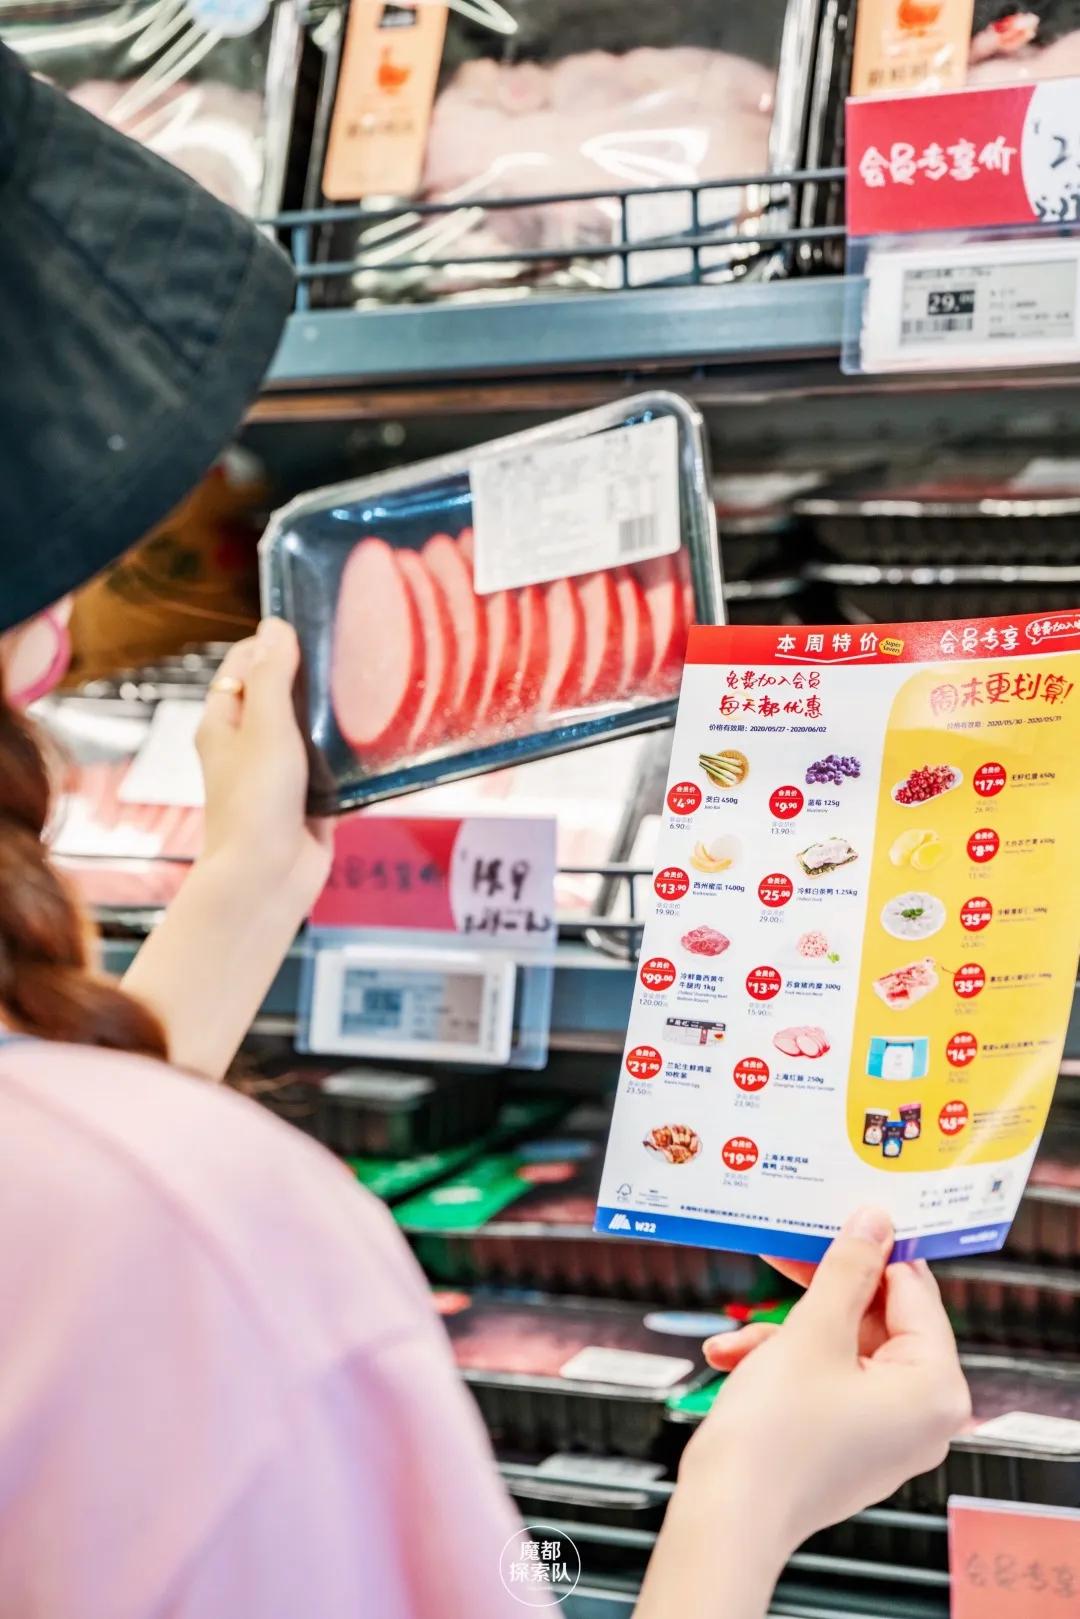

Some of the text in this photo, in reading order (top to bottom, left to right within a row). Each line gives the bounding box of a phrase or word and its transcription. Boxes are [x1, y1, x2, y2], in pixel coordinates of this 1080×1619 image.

[859, 135, 1018, 188] 会员专享价
[777, 632, 879, 653] 本周特价
[939, 625, 1020, 654] 会员专享
[726, 670, 821, 690] 免费加入会员
[719, 695, 823, 719] 每天都优惠
[673, 798, 695, 808] ¥4.90
[722, 797, 738, 805] 450g
[775, 801, 798, 813] ¥9.90
[824, 799, 840, 807] 125g
[656, 883, 687, 894] ¥13.90
[635, 1221, 657, 1233] W22
